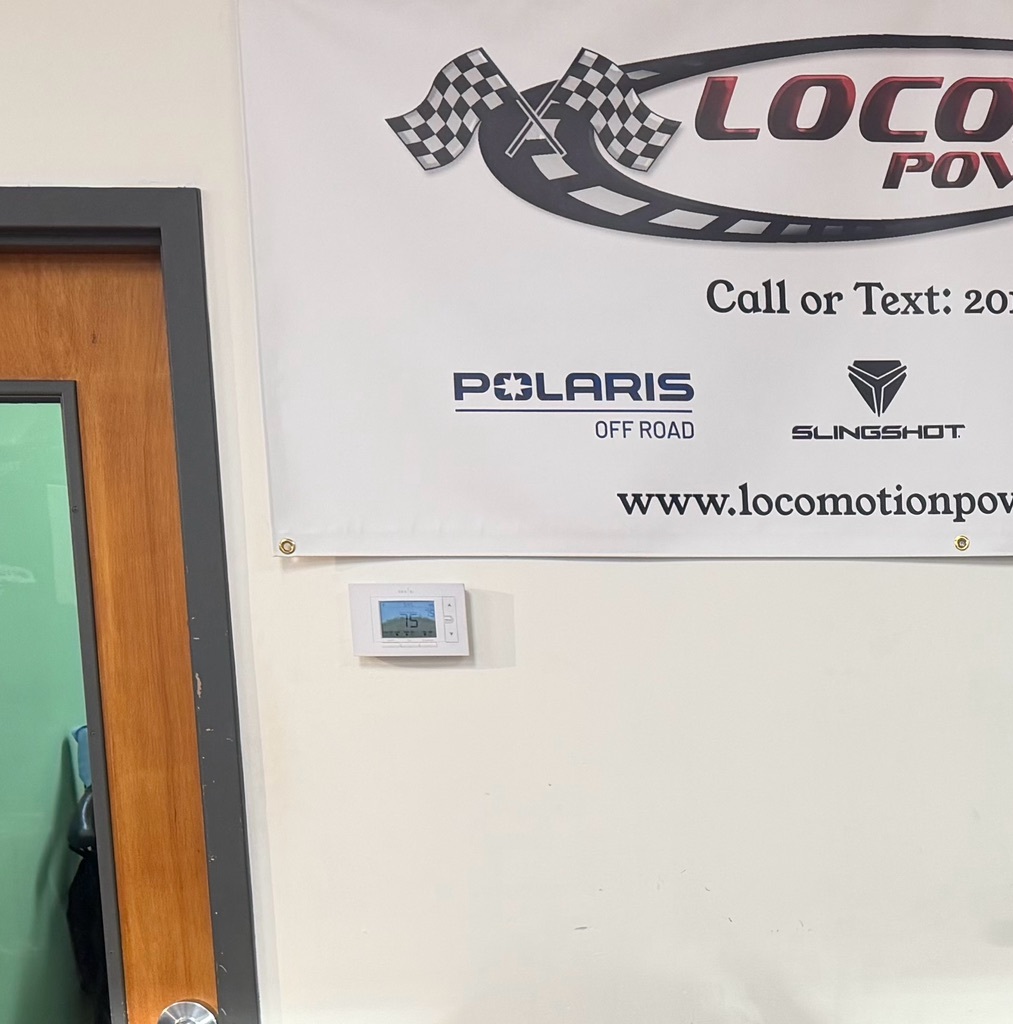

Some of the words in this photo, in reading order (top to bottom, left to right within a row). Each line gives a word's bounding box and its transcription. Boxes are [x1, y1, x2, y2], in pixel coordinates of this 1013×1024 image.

[706, 278, 790, 315] Call
[800, 291, 844, 315] or
[853, 281, 952, 316] Text:
[453, 372, 695, 402] POLARIS
[595, 420, 634, 439] OFF
[639, 420, 695, 439] ROAD
[791, 424, 966, 440] SLINGSHOT
